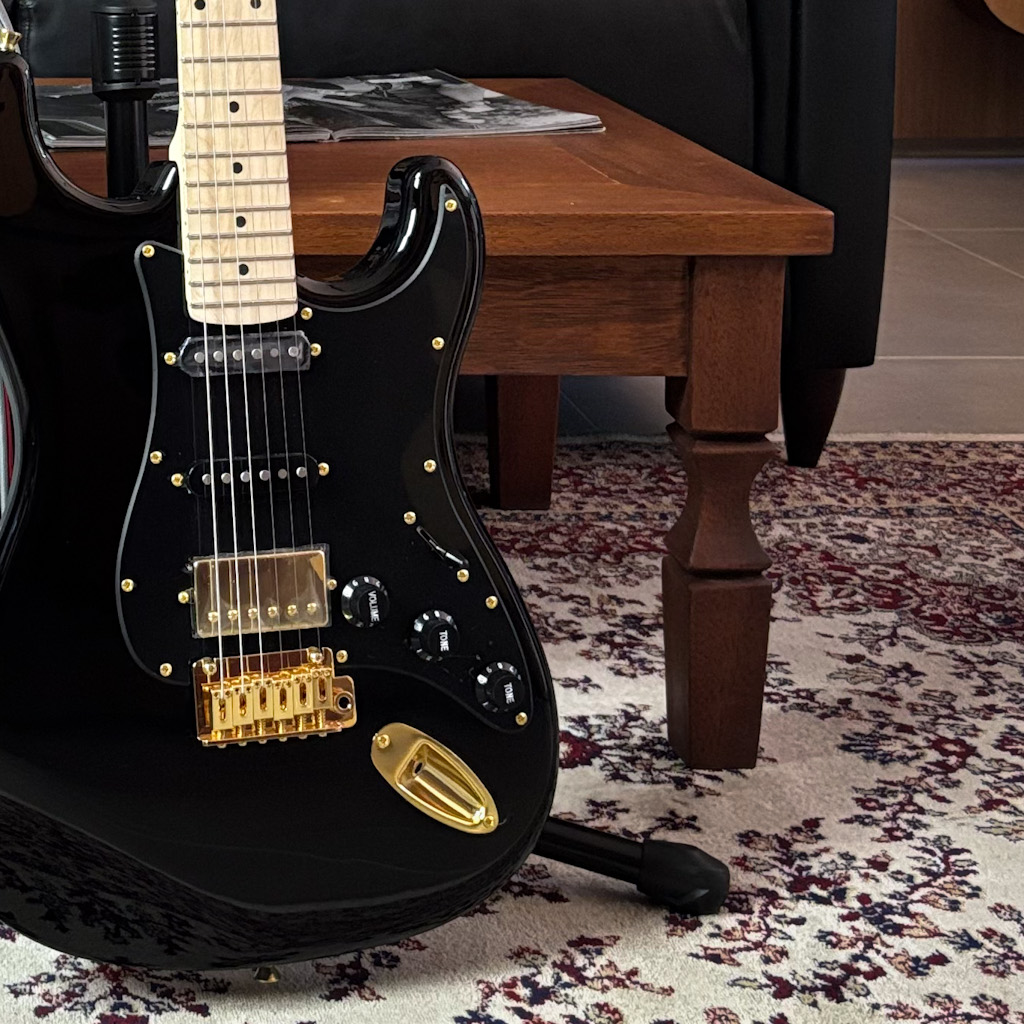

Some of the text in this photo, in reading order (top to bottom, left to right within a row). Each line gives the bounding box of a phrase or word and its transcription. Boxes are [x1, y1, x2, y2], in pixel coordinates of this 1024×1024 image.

[368, 590, 380, 622] VOLUME
[439, 629, 450, 652] TONE
[503, 681, 516, 705] TONE
